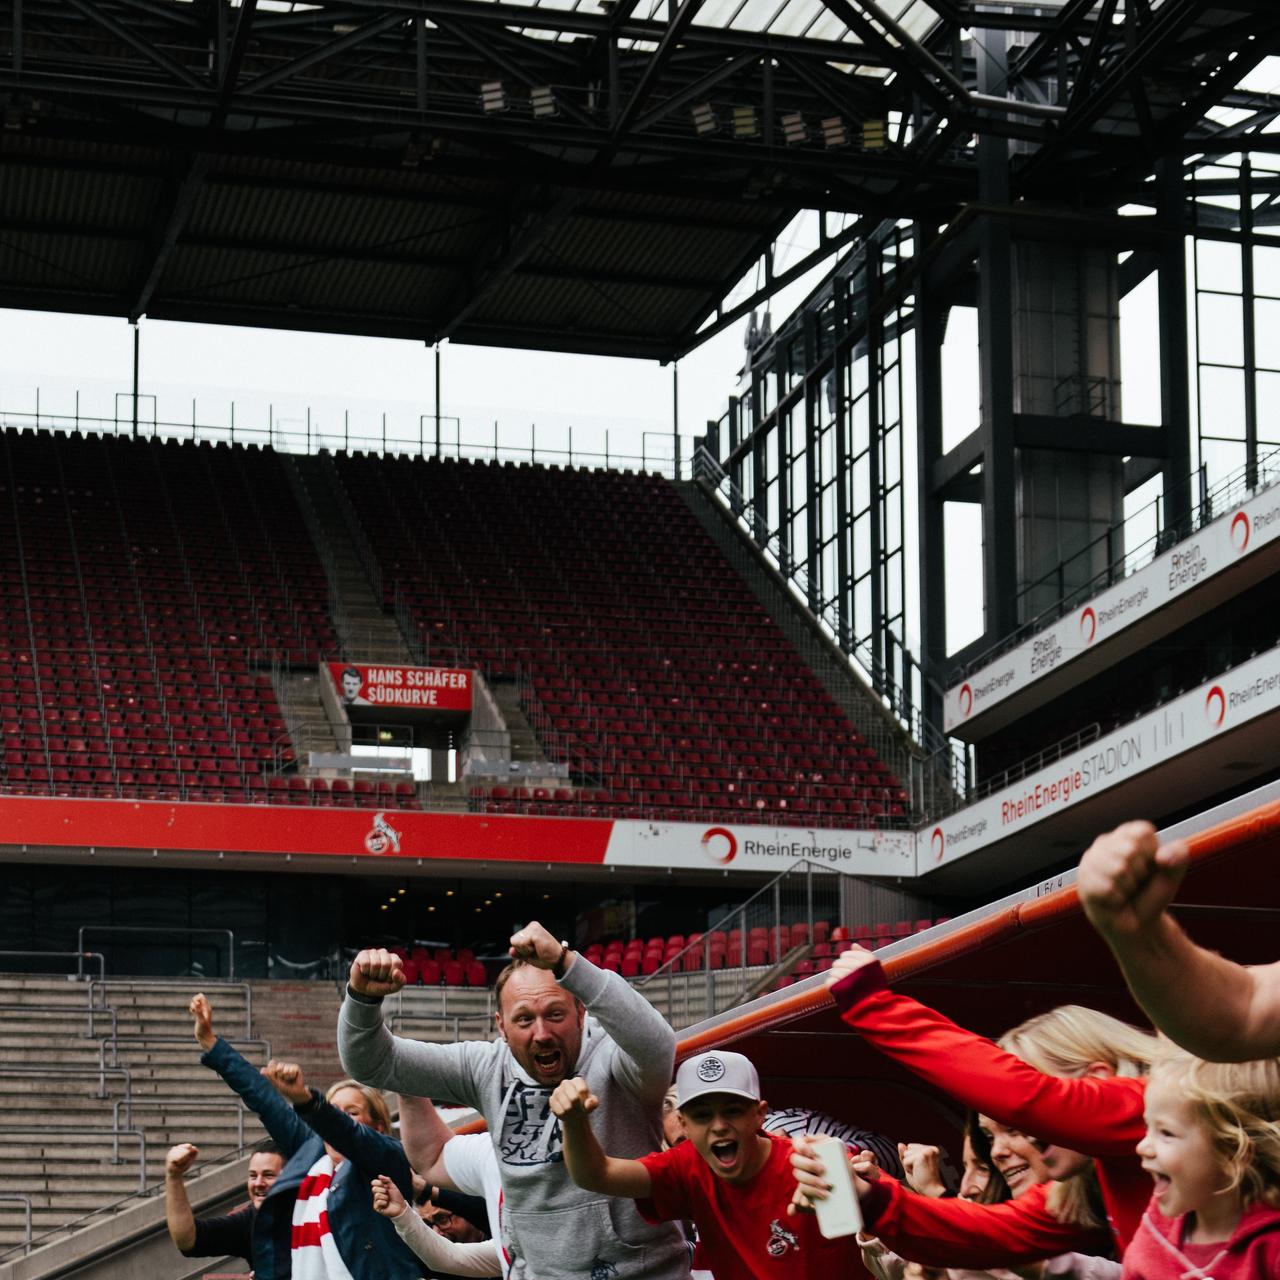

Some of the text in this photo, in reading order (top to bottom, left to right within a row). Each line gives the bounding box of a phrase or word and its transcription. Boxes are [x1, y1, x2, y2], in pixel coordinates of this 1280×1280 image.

[1171, 544, 1201, 571] Rhein
[1168, 556, 1208, 592] Energie
[1098, 587, 1150, 626] RheinEnergie
[1033, 633, 1058, 656] Rhein
[1030, 645, 1063, 675] Energie
[367, 668, 467, 689] HANS SCHÄFER
[973, 668, 1016, 701] RheinEnergie
[367, 686, 438, 705] SÜDKURVE
[946, 817, 988, 847] RheinEnergie
[743, 840, 852, 861] RheinEnergie
